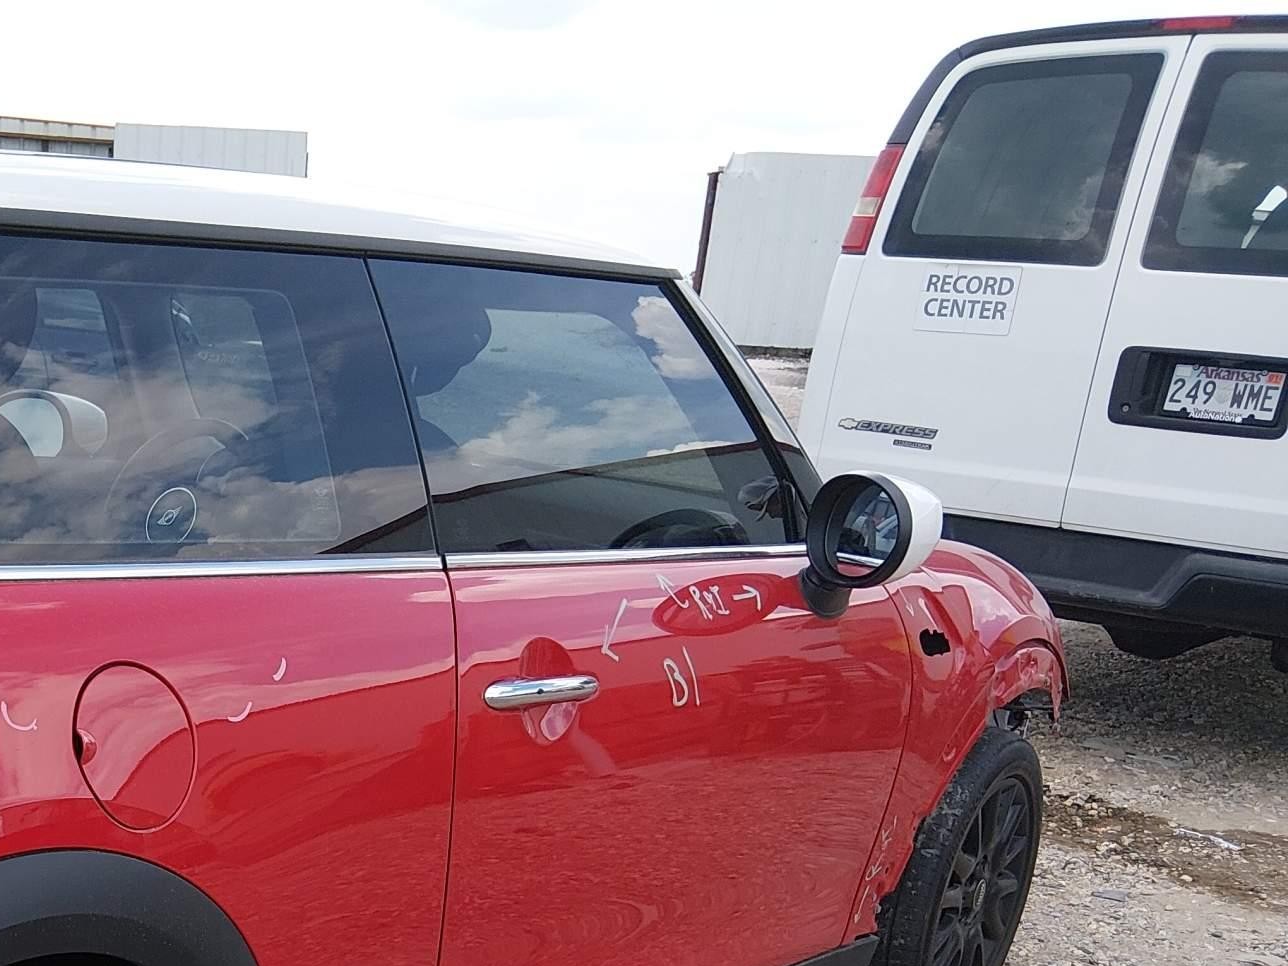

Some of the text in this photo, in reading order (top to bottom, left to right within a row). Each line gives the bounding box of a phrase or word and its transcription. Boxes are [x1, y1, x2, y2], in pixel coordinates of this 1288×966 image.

[925, 274, 1015, 296] RECORD
[923, 298, 1007, 320] CENTER
[1197, 366, 1262, 383] Arkansas
[1168, 378, 1280, 412] 249 WME
[856, 420, 938, 438] EXPRESS
